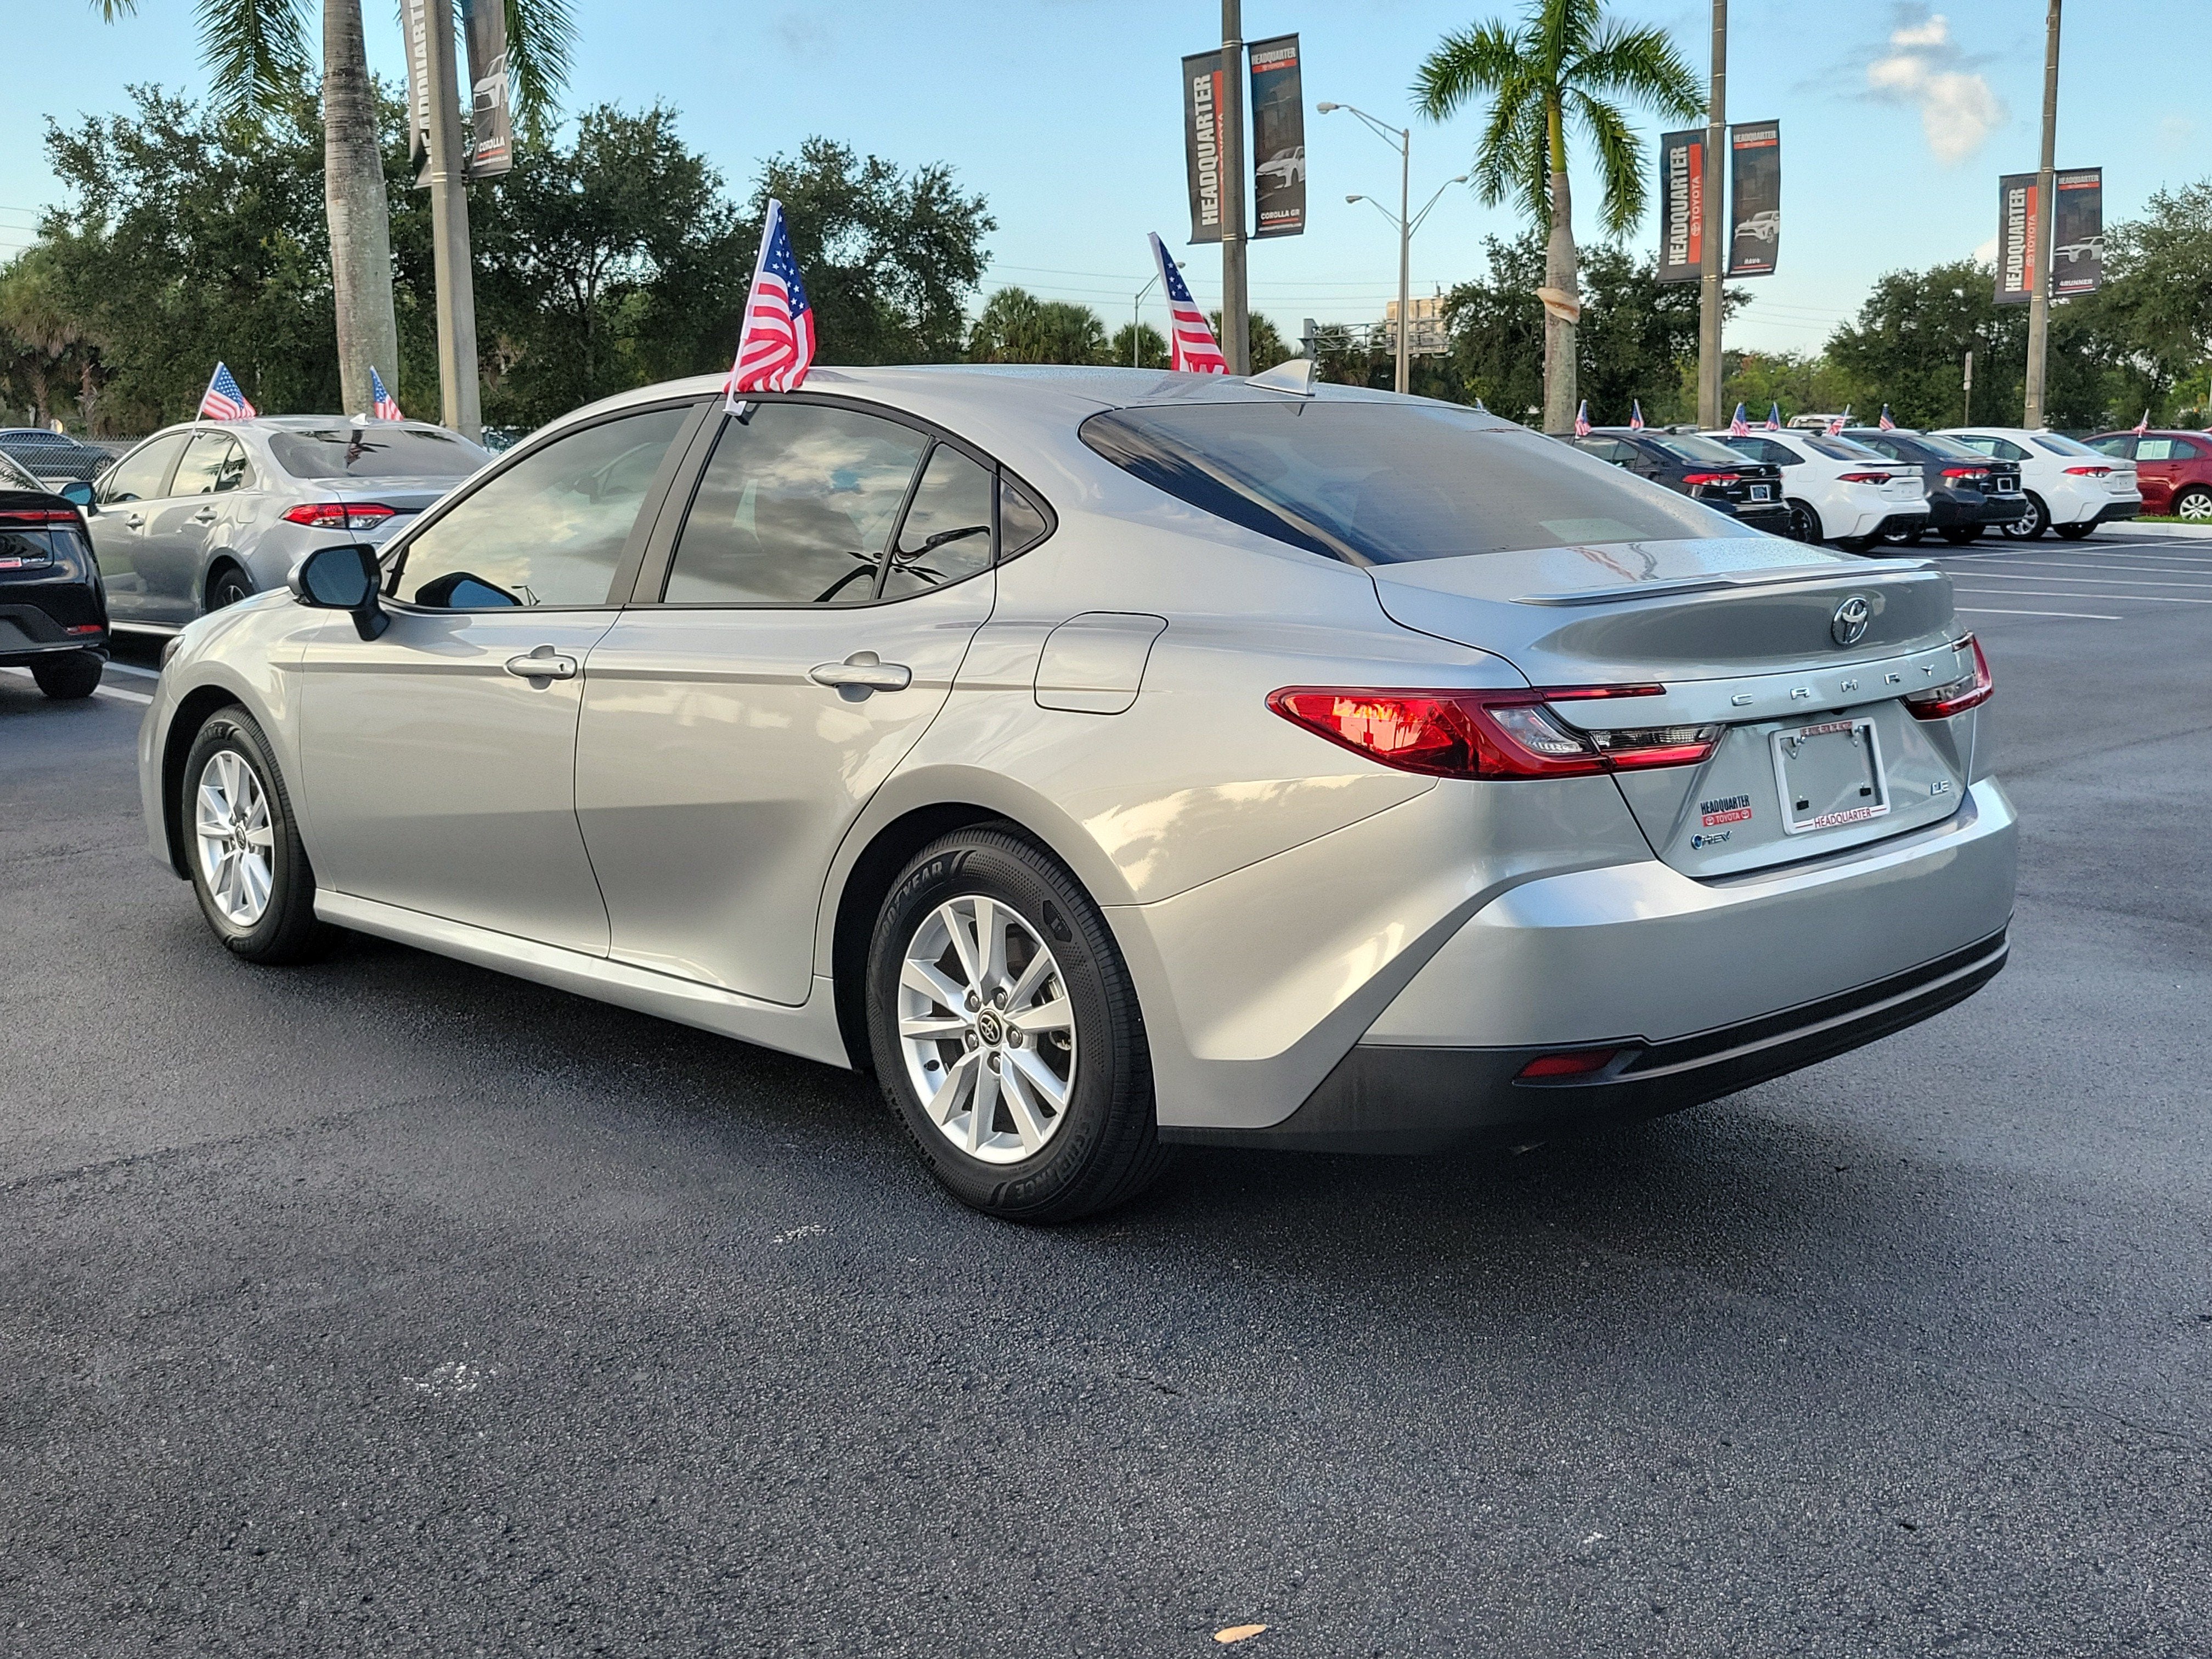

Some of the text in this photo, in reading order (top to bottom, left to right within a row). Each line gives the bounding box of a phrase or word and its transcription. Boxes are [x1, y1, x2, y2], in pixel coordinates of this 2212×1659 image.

[1193, 74, 1218, 226] HEADQUARTER
[1668, 146, 1690, 266] HEADQUARTER
[1691, 175, 1701, 221] TOYOTA
[1261, 210, 1289, 220] COROLLA
[2005, 188, 2025, 292] HEADQUARTER
[1731, 664, 1936, 706] CAMRY
[1931, 780, 1950, 795] LE
[1700, 794, 1750, 816] HEADQUARTER
[1716, 812, 1741, 824] TOYOTA
[1814, 808, 1871, 828] HEADQUARTER
